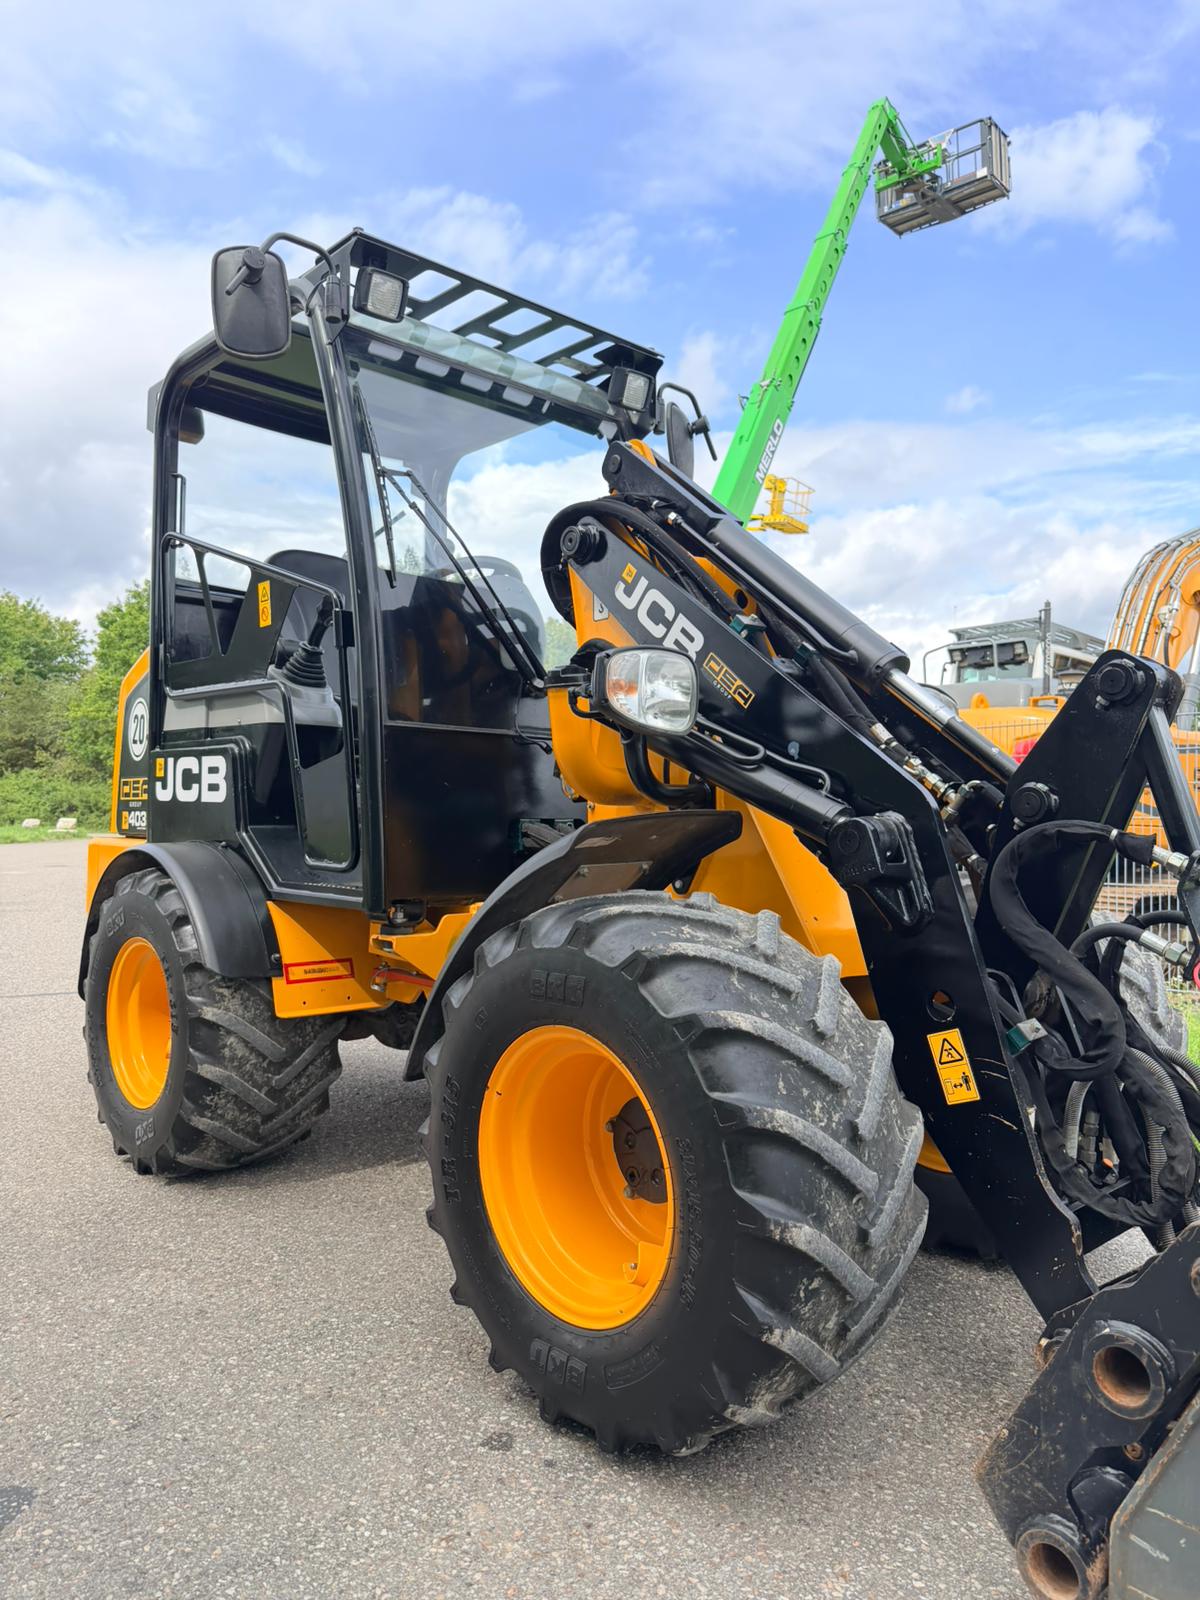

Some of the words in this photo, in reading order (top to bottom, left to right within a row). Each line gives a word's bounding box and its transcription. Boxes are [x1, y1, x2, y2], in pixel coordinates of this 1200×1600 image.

[755, 418, 783, 484] MERLO
[614, 575, 705, 662] JCB
[133, 713, 146, 745] 20
[155, 755, 227, 803] JCB
[129, 811, 147, 828] 403
